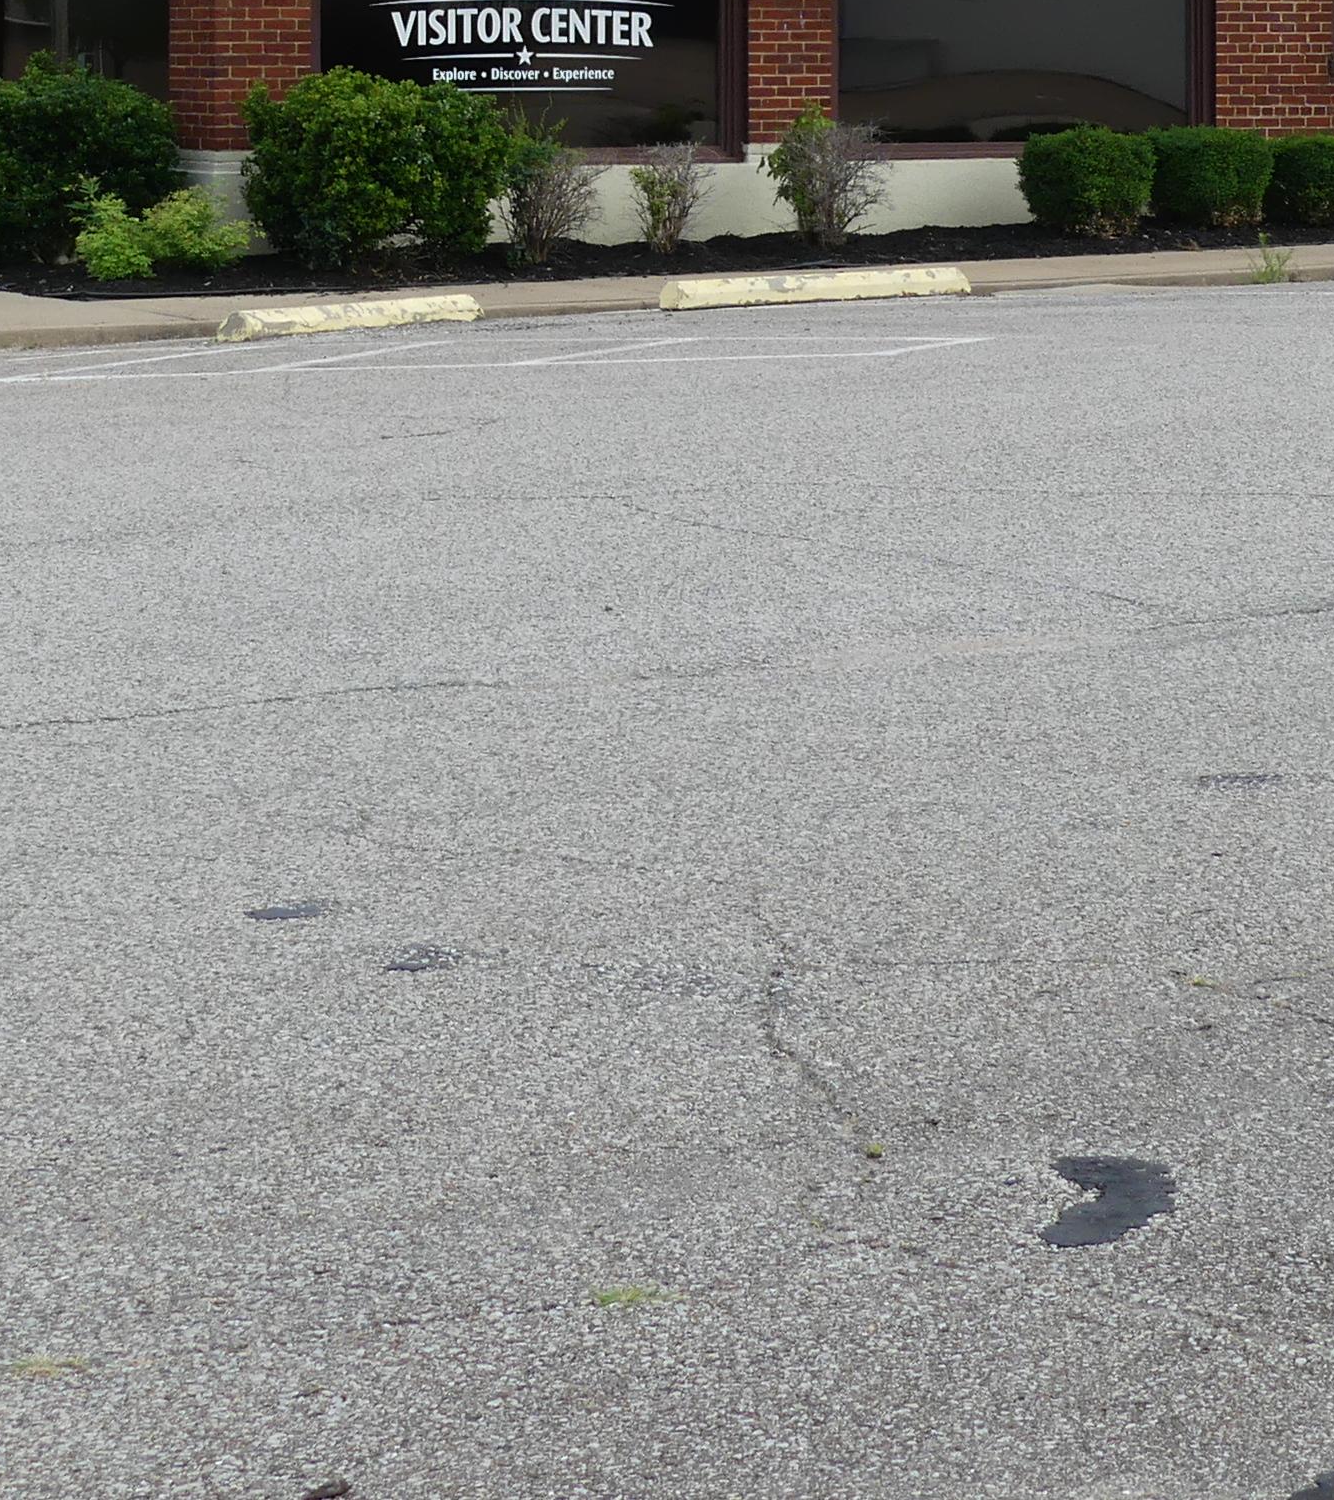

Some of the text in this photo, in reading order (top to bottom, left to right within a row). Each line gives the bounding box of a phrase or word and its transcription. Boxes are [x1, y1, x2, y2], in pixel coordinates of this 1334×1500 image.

[391, 8, 654, 47] VISITOR CENTER
[433, 67, 615, 83] Explore Discover Experience
